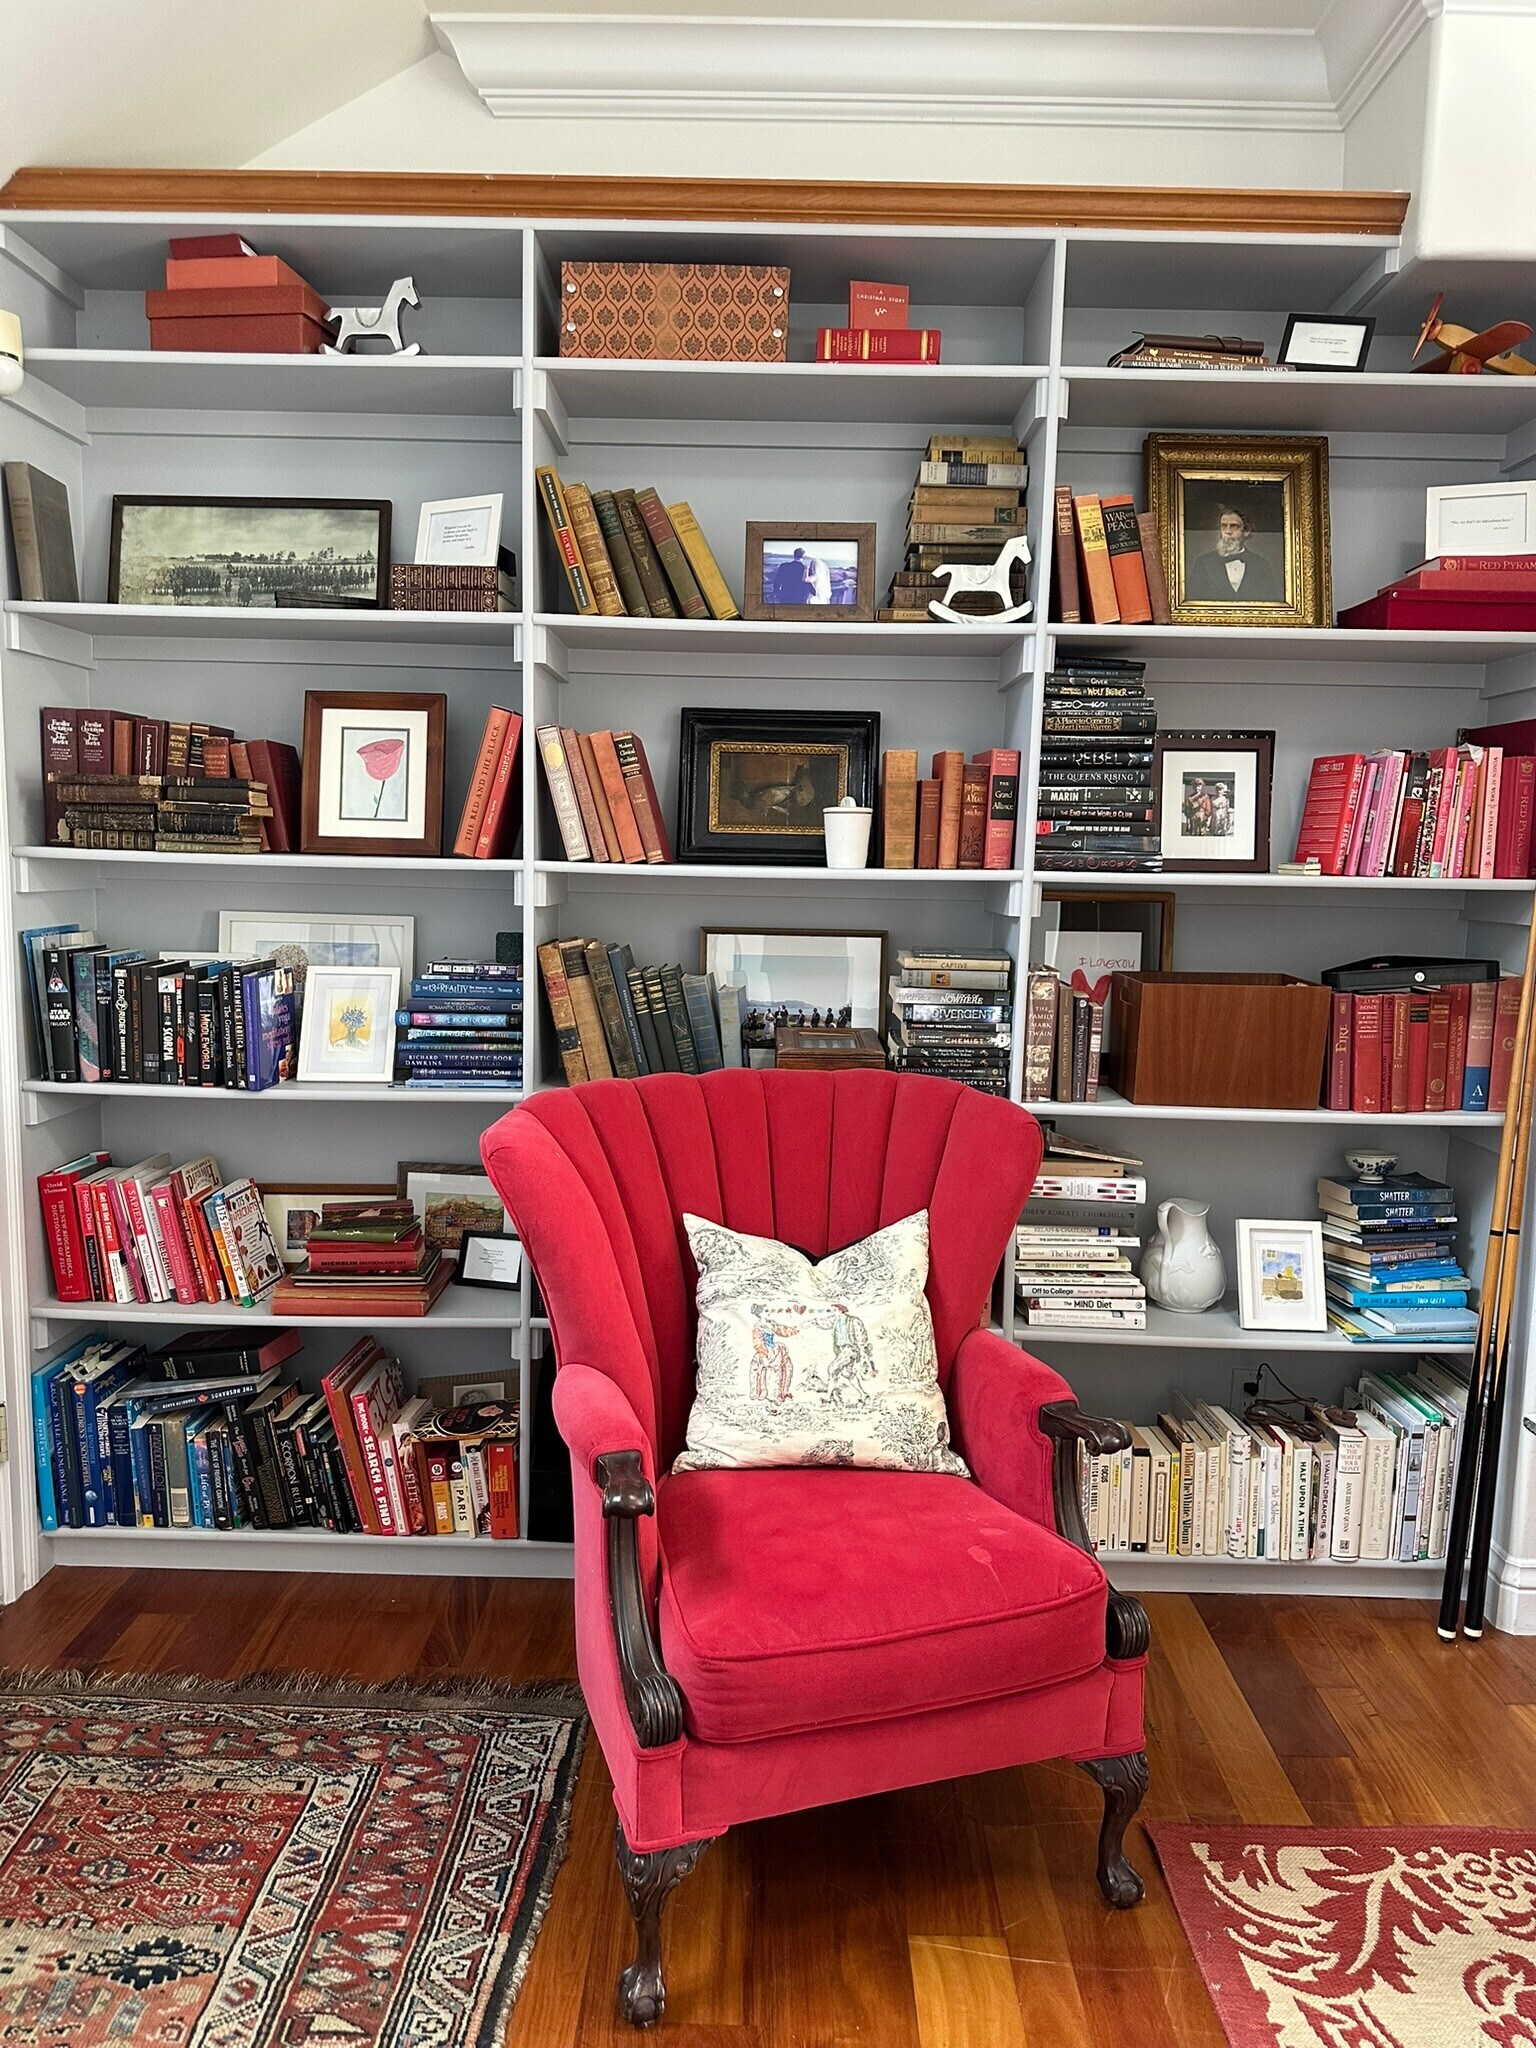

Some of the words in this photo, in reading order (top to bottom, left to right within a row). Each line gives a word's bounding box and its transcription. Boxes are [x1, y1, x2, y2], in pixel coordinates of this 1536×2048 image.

[1105, 511, 1125, 522] WAR
[1107, 519, 1136, 532] PEACE
[498, 754, 511, 783] pattern
[1073, 752, 1123, 766] REBEL
[464, 822, 475, 841] THE
[470, 801, 480, 820] RED
[475, 779, 486, 799] AND
[481, 757, 491, 777] THE
[486, 724, 500, 755] BLACK
[1067, 773, 1102, 782] QUEEN'S
[1104, 774, 1133, 784] RISING
[992, 802, 1014, 810] Alliance
[1051, 792, 1079, 801] MARIN
[117, 978, 126, 999] ALEX
[940, 996, 984, 1004] NOWHERE
[117, 1010, 126, 1035] RIDER
[932, 1009, 993, 1019] DIVERGENT
[163, 1027, 174, 1060] SCORPIA
[200, 1014, 211, 1070] MIDDLEWORLD
[224, 1020, 232, 1050] Graveyard
[1335, 1023, 1349, 1054] FIRE
[1472, 1085, 1483, 1096] A
[82, 1189, 91, 1212] Homo
[236, 1195, 245, 1206] 175
[1379, 1192, 1410, 1201] SHATTER
[127, 1189, 145, 1230] SAPIENS
[217, 1206, 228, 1222] 175
[1050, 1209, 1079, 1217] ROBERTS
[1083, 1210, 1124, 1218] CHURCHILL
[1385, 1207, 1414, 1217] SHATTER
[51, 1204, 62, 1246] DICTIONARY
[85, 1212, 93, 1231] Deus
[62, 1229, 74, 1278] BIOGRAPHICAL
[139, 1238, 149, 1255] Yuval
[162, 1209, 177, 1247] DICTIONARY
[174, 1255, 186, 1284] THEORIES
[221, 1221, 242, 1272] PAPERCRAFTS
[1082, 1250, 1101, 1259] Piglet
[144, 1254, 153, 1269] Noah
[148, 1269, 158, 1289] Harari
[1074, 1300, 1094, 1308] MIND
[1097, 1300, 1112, 1308] Diet
[211, 1387, 240, 1399] HUSBANDS
[75, 1401, 86, 1439] CHILDREN'S
[36, 1418, 45, 1445] PRIVATE
[39, 1446, 47, 1468] VIEWS
[87, 1434, 96, 1465] KINGFISHER
[79, 1441, 91, 1487] ENCYCLOPEDIA
[1185, 1448, 1194, 1477] Didion
[200, 1473, 208, 1490] Life
[281, 1439, 298, 1485] SCORPION
[291, 1486, 304, 1516] RULES
[363, 1435, 382, 1484] SEARCH
[377, 1496, 391, 1527] FIND
[1100, 1465, 1109, 1483] FOCUS
[1372, 1463, 1380, 1485] Century
[405, 1473, 420, 1505] ELITE
[1184, 1477, 1193, 1493] The
[435, 1501, 448, 1521] PARIS
[454, 1489, 468, 1522] PARIS
[1183, 1493, 1193, 1516] White
[1320, 1489, 1329, 1529] DREAMERS
[1379, 1496, 1387, 1511] Short
[1182, 1519, 1192, 1544] Album
